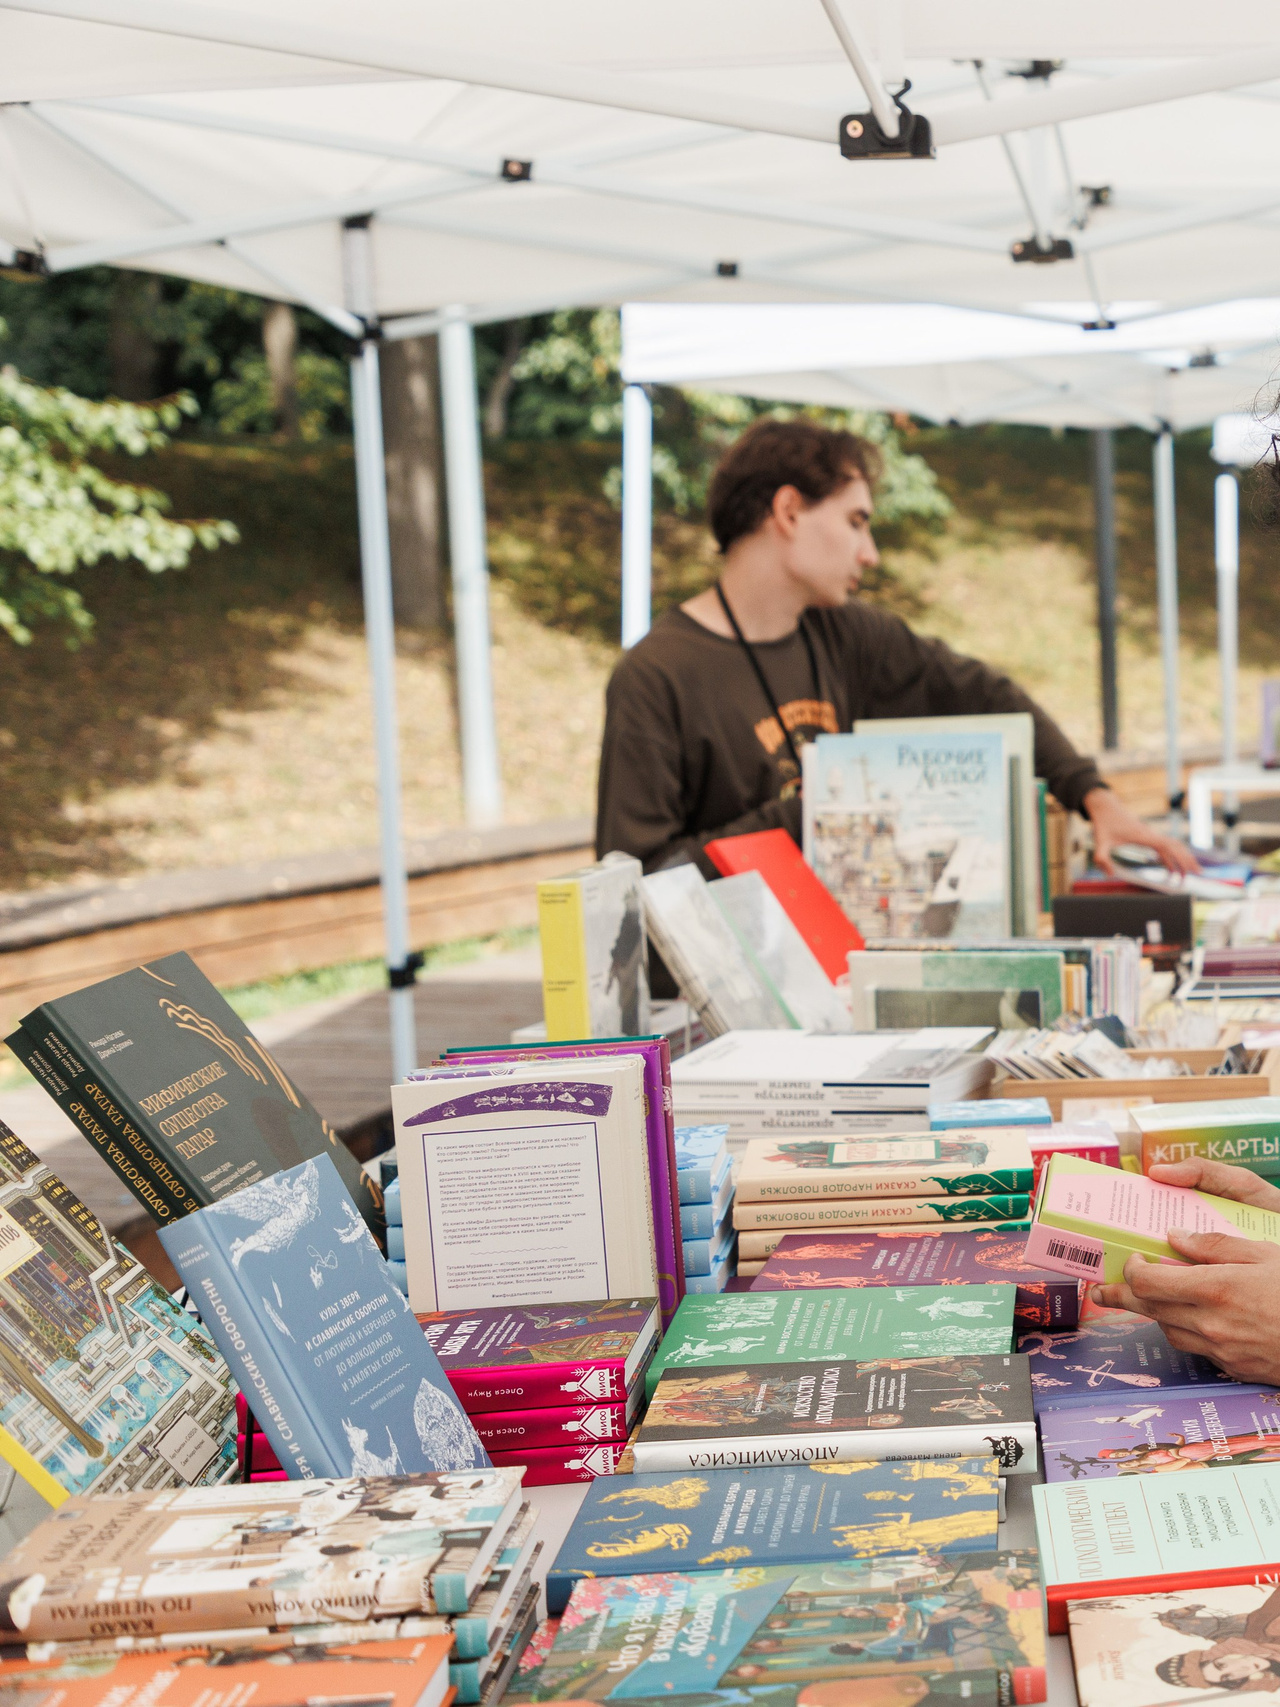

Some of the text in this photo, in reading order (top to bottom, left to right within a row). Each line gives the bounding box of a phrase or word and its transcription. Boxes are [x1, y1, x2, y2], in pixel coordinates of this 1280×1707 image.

[88, 1029, 126, 1049] Ринара Нагаева
[97, 1038, 134, 1060] Дарина Ерохина
[138, 1061, 228, 1116] МИФИЧЕСКИЕ
[159, 1092, 229, 1137] СУЩЕСТВА
[69, 1101, 171, 1217] СУЩЕСТВА ТАТАР
[84, 1082, 186, 1199] СУЩЕСТВА ТАТАР
[175, 1127, 218, 1160] ТАТАР
[1155, 1137, 1279, 1163] КПТ-КАРТЫ
[1032, 1152, 1090, 1171] КАТЫ
[760, 1181, 917, 1195] СКАЗКИ НАРОДОВ ПОВОЛЖЬЯ
[756, 1207, 912, 1222] СКАЗКИ НАРОДОВ ПОВОЛЖЬЯ
[178, 1243, 204, 1260] МАРИНА
[180, 1250, 210, 1269] ГОЛУБЕВА
[304, 1294, 389, 1352] И СЛАВЯНСКИЕ ОБОРОТНИ
[319, 1291, 360, 1321] КУЛЬТ ЗВЕРЯ
[314, 1308, 397, 1368] ОТ ЛЮТИЧЕЙ И БЕРЕНДЕЕВ
[435, 1335, 470, 1355] БАБЫ
[452, 1319, 483, 1334] ЯГИ
[335, 1332, 394, 1377] ДО ВОЛКОДЛАКОВ
[341, 1345, 404, 1393] И ЗАКЛЯТЫХ СОРОК
[201, 1278, 316, 1481] ЕРЯ И СЛАВЯНСКИЕ ОБОРОТНИ
[468, 1387, 524, 1398] Олеся Яжук
[794, 1375, 817, 1418] ИСКУССТВО
[815, 1367, 841, 1425] АПОКАЛИПСИСА
[497, 1427, 526, 1436] Олеся
[1183, 1418, 1203, 1442] МАГИЯ
[1198, 1401, 1230, 1453] СРЕДНЕВЕКОВЬЕ
[688, 1446, 839, 1467] АПОКАЛИПСИСА
[712, 1482, 740, 1543] ПОГРЕБАЛЬНЫЕ ОБРЯДЫ
[736, 1489, 756, 1528] КУЛЬТ ПРЕДКОВ
[755, 1506, 769, 1524] ЗАВЕТА
[761, 1488, 774, 1505] ОДИНА
[792, 1502, 806, 1527] ПОХОРОН
[770, 1503, 788, 1541] НЕКРОМАНТИИ
[1062, 1486, 1101, 1578] ПСИХОЛОГИЧЕСКИЙ
[1102, 1502, 1135, 1554] ИНТЕЛЛЕКТ
[1160, 1502, 1179, 1542] Главная книга
[1177, 1493, 1203, 1548] для формирования
[1195, 1495, 1220, 1541] эмоциональной
[1217, 1496, 1238, 1536] устойчивости
[50, 1598, 192, 1620] ПО ЧЕТВЕРГАМ
[247, 1594, 380, 1615] МИТИКО АОЯМА
[91, 1620, 155, 1635] КАКАО
[605, 1587, 661, 1672] Что я узнала
[648, 1589, 689, 1661] в книжном
